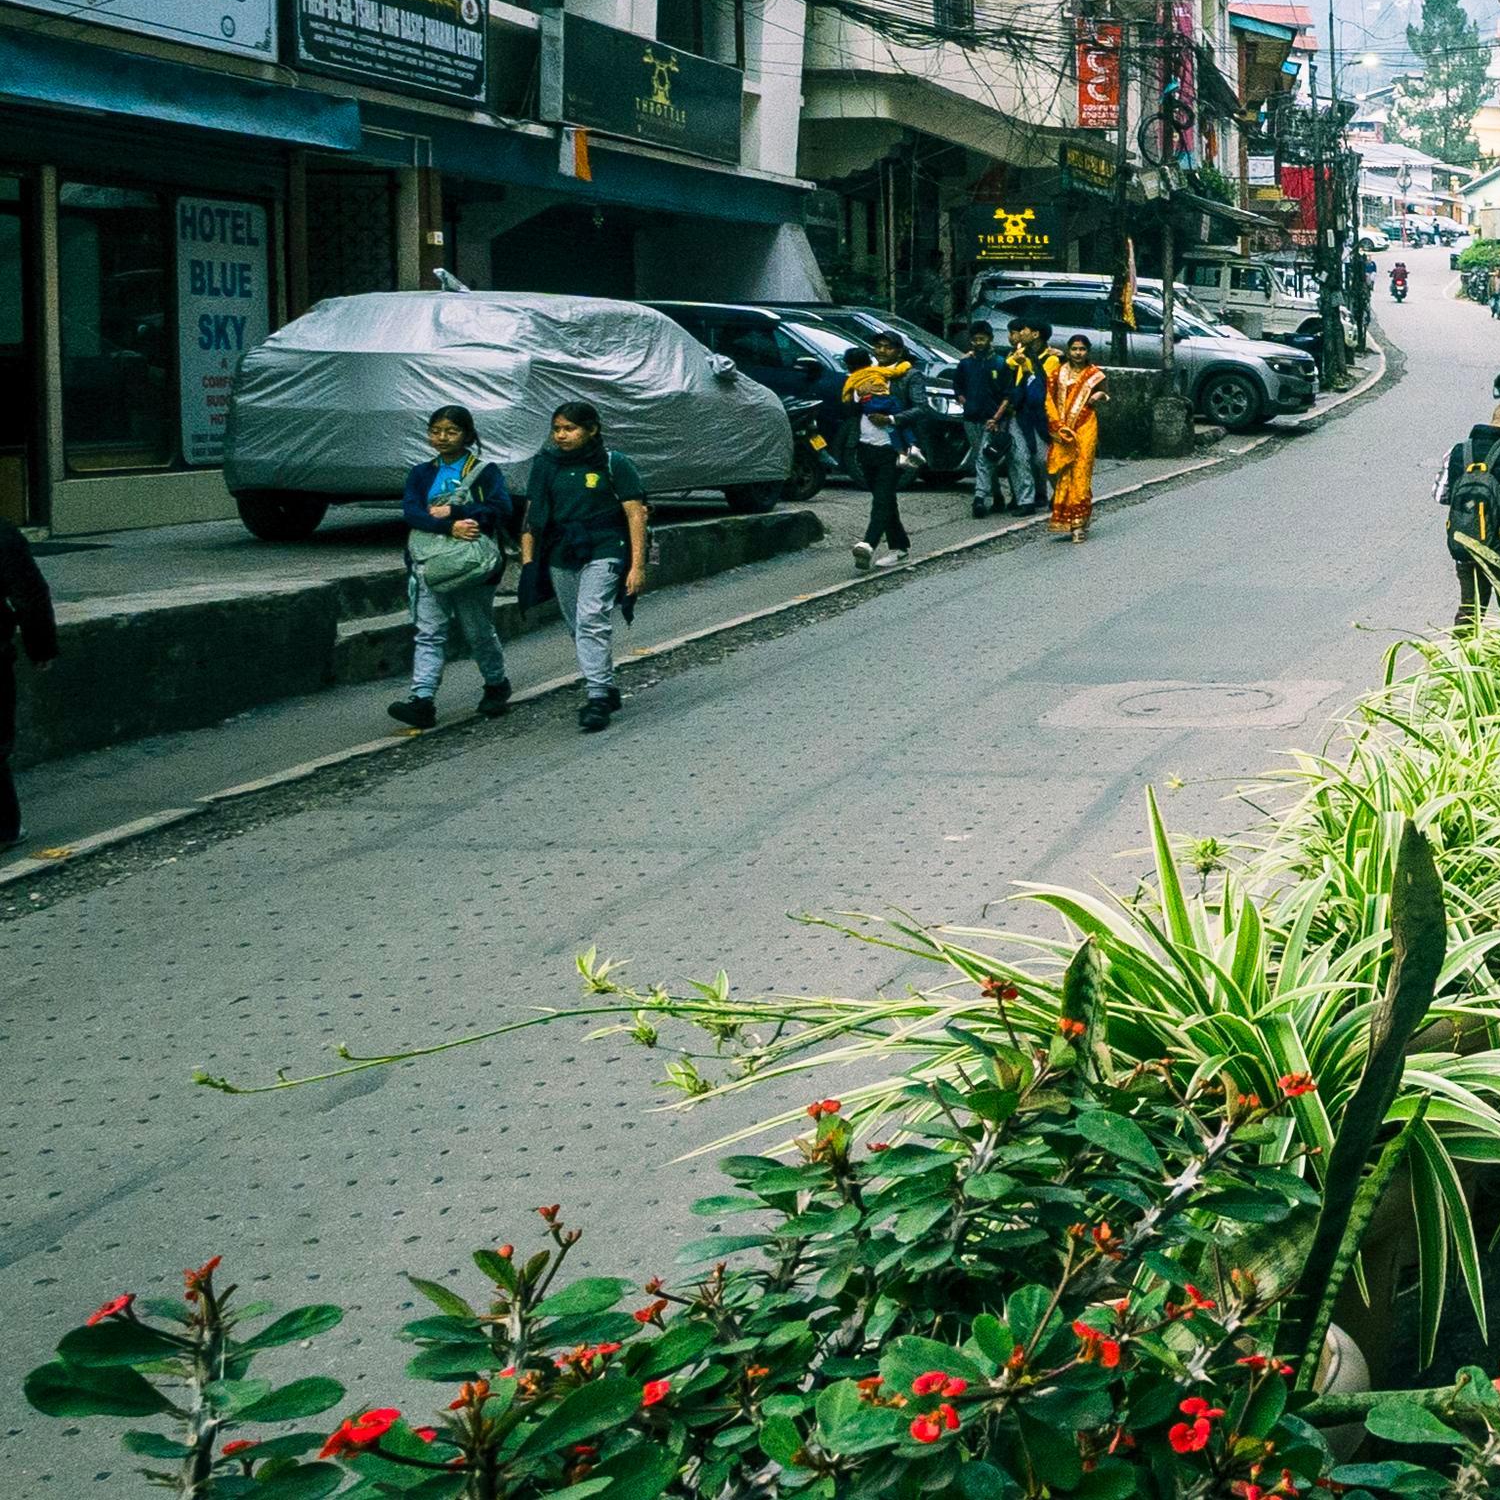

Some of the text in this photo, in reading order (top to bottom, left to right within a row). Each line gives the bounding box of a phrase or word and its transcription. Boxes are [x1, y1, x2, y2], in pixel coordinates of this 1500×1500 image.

[635, 97, 687, 124] THROTTLE
[180, 204, 259, 247] HOTEL
[978, 234, 1050, 244] THROTTLE
[190, 259, 252, 298] BLUE
[198, 314, 247, 351] SKY
